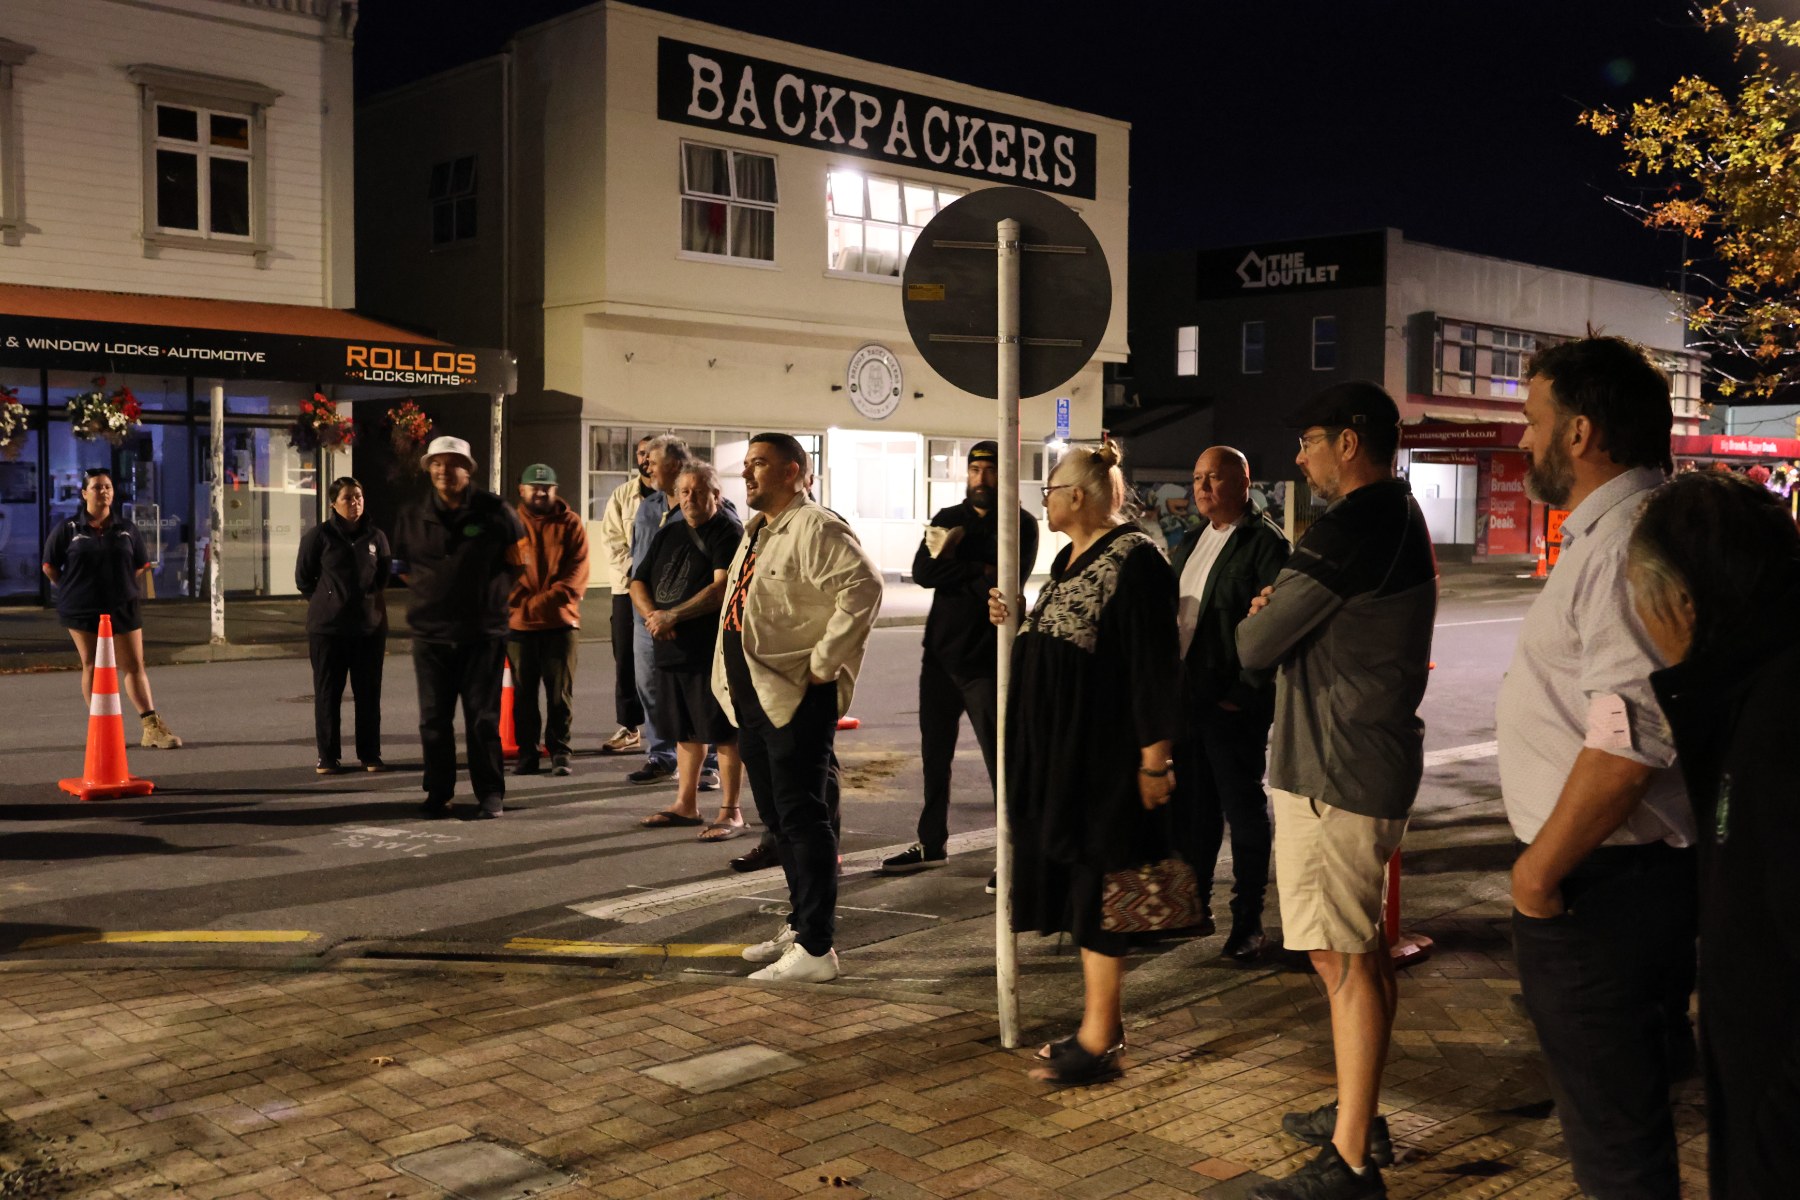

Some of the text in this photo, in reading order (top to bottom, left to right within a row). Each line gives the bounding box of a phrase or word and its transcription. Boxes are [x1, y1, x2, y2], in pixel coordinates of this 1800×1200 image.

[687, 53, 1076, 187] BACKPACKERS
[1267, 252, 1305, 269] THE
[1267, 265, 1339, 286] OUTLET
[6, 336, 265, 362] & WINDOW LOCKS AUTOMOTIVE
[346, 345, 476, 374] ROLLOS
[364, 370, 460, 385] LOCKSMITHS
[1491, 460, 1505, 478] Big
[1491, 477, 1524, 492] Brands.
[1490, 496, 1515, 515] Bigger
[1490, 515, 1517, 529] Deals.
